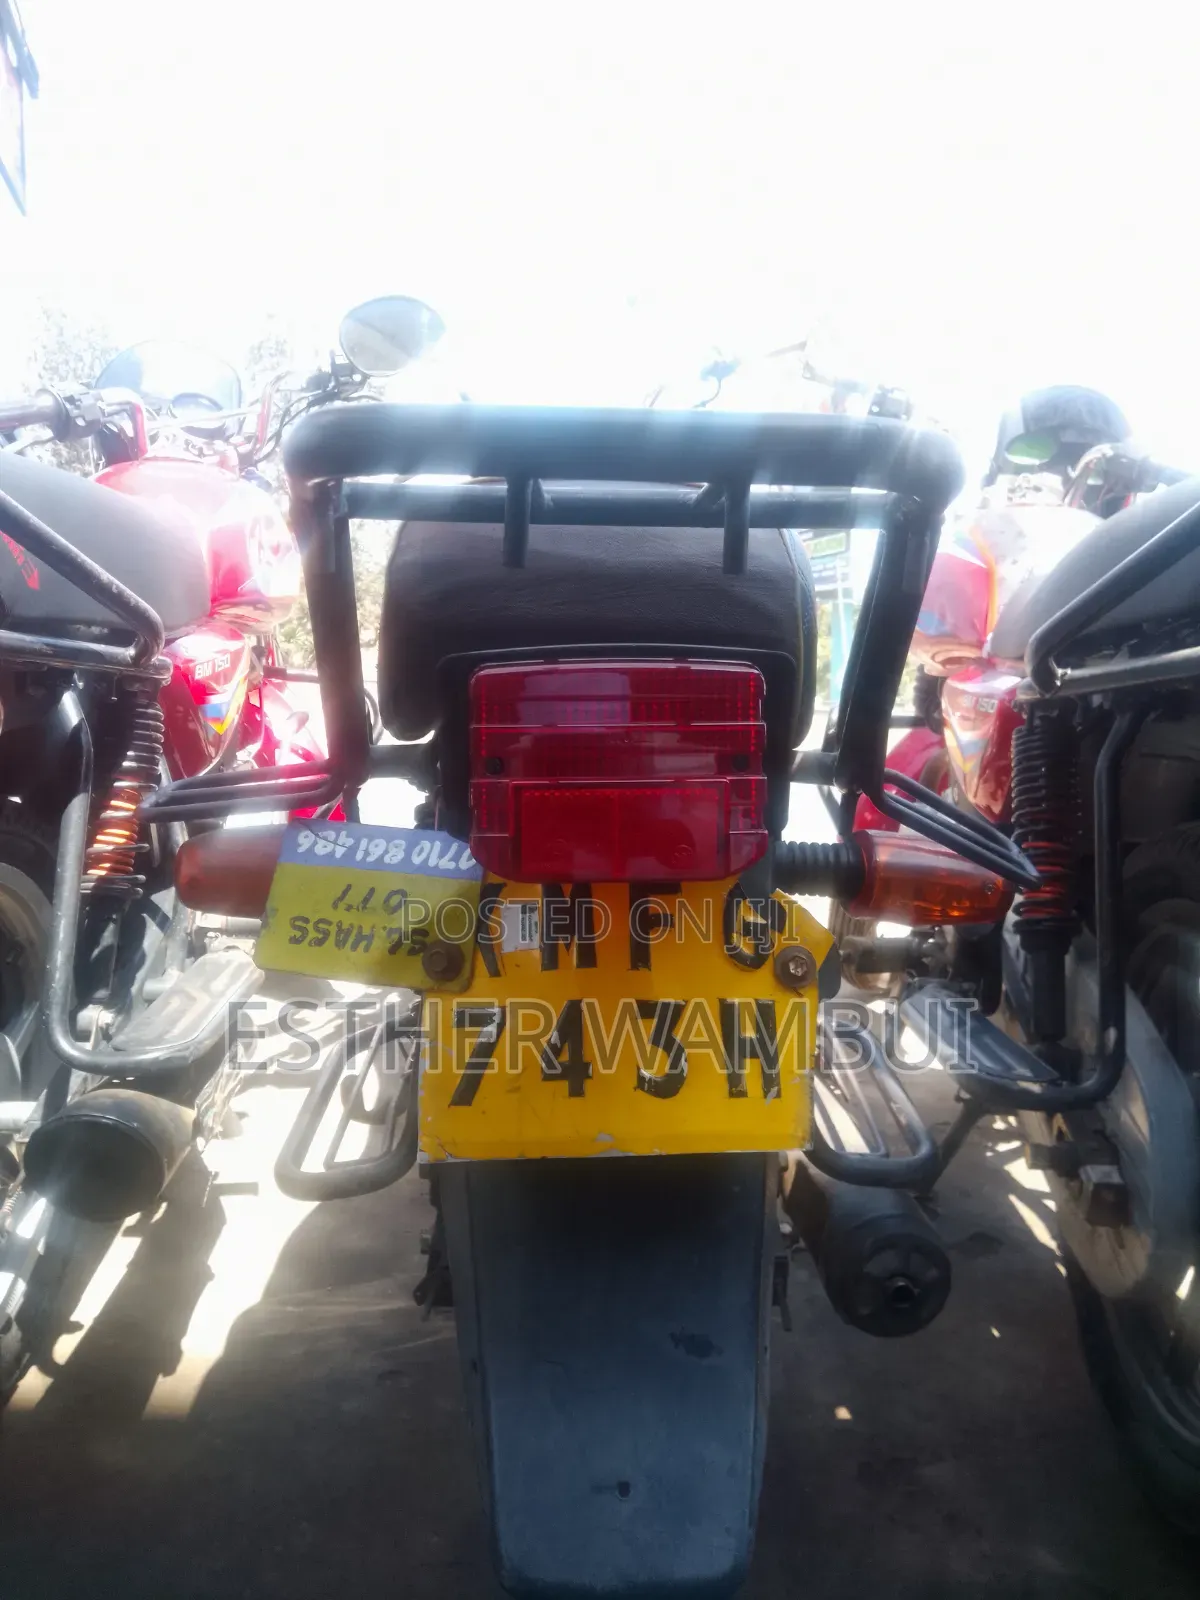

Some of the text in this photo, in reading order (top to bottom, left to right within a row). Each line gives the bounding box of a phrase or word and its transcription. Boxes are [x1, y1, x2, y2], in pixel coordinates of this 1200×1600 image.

[977, 697, 998, 713] 150
[296, 829, 355, 860] 486
[355, 837, 406, 865] 861
[448, 997, 783, 1107] 743H
